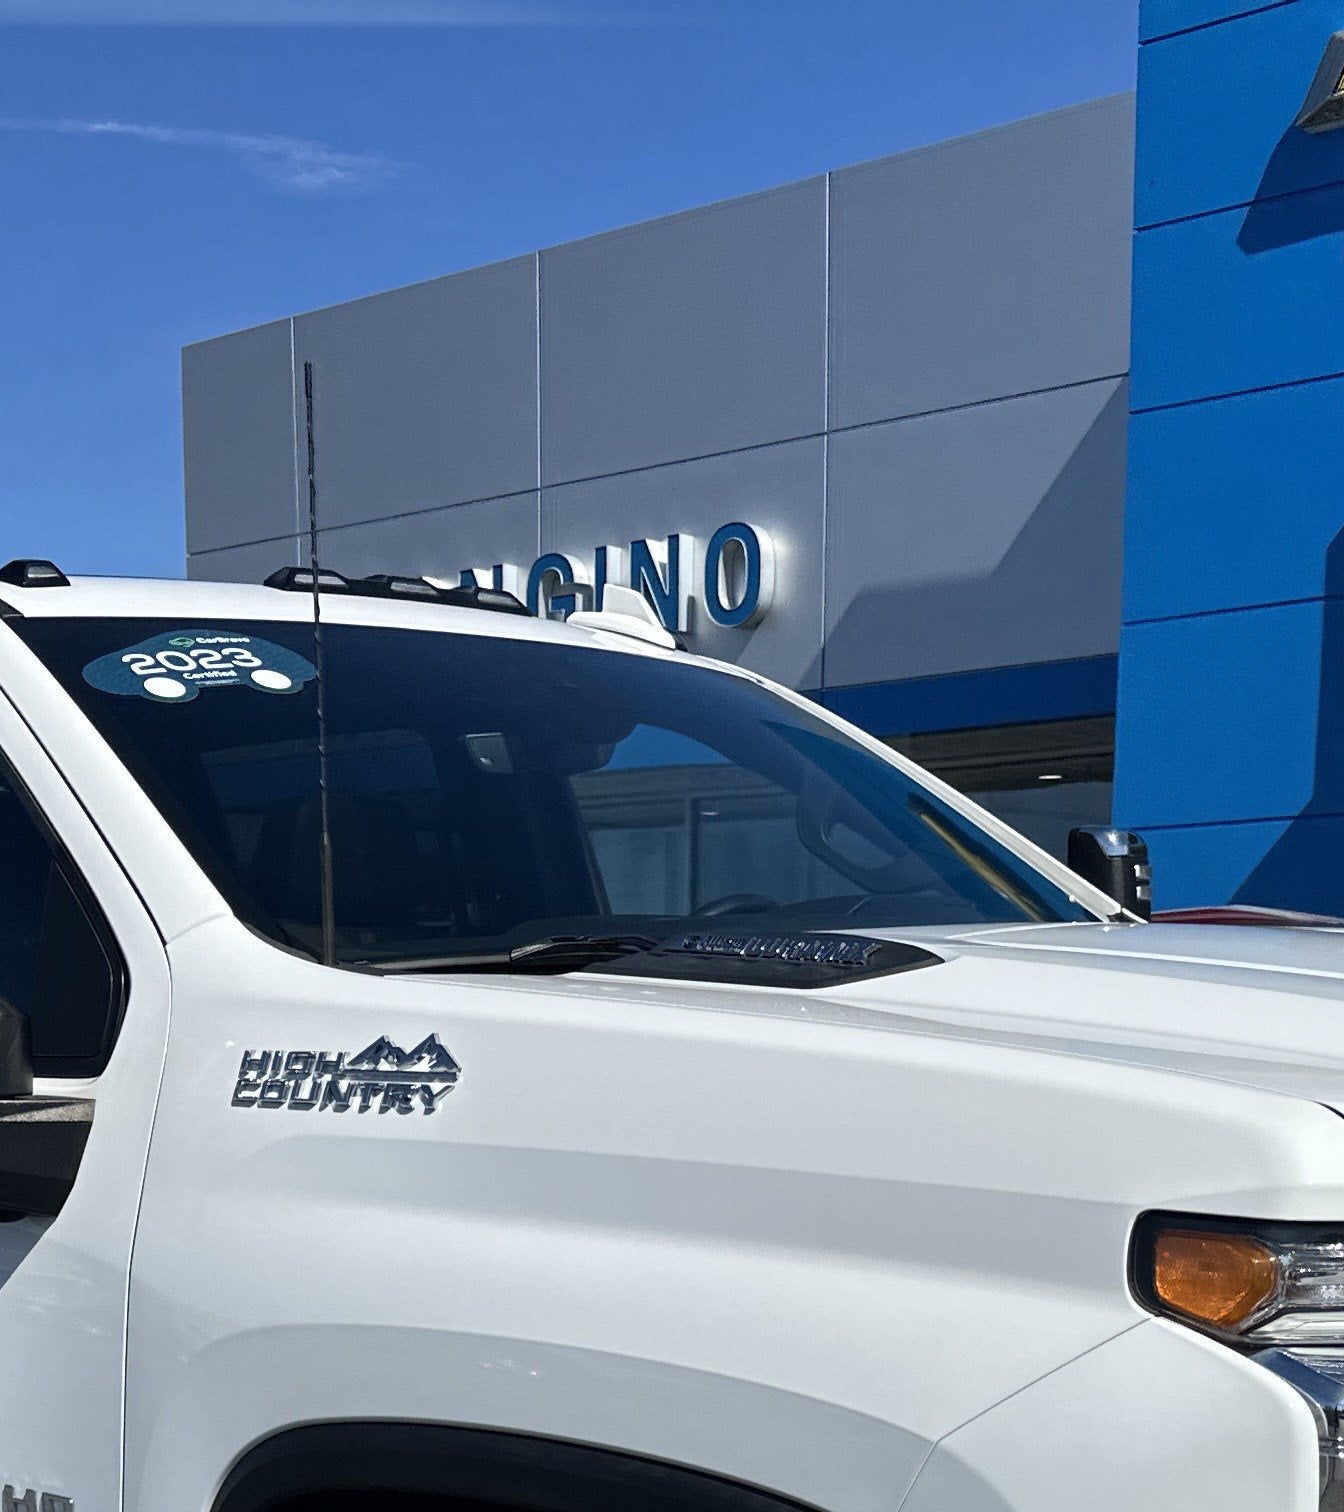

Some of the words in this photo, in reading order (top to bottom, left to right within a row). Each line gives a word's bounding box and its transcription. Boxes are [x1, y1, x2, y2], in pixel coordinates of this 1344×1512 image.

[121, 648, 262, 675] 2023
[183, 669, 237, 680] Certified
[239, 1050, 346, 1079] HIGH
[232, 1079, 455, 1115] COUNTRY
